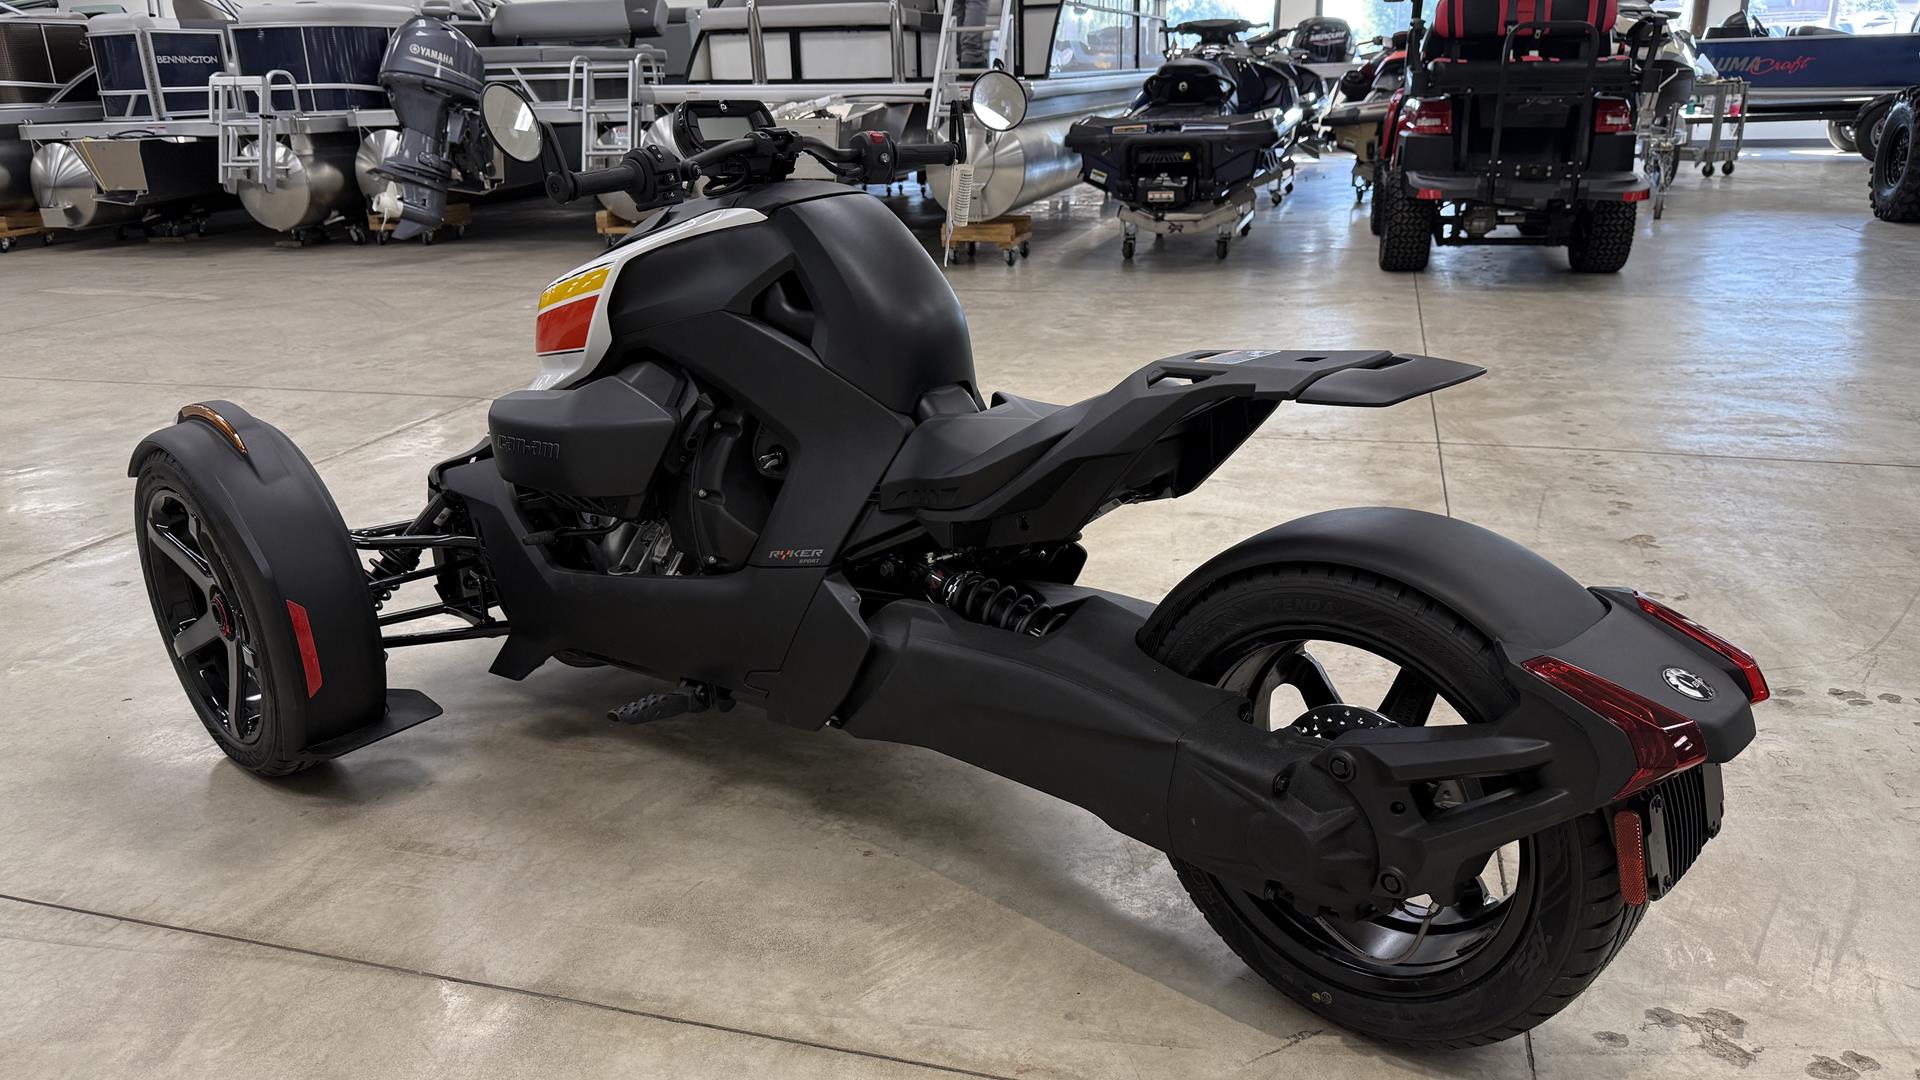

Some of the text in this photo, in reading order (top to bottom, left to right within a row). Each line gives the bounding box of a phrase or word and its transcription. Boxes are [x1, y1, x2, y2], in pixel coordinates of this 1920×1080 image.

[156, 55, 218, 64] BENNINGTON
[420, 46, 454, 66] YAMAHA
[498, 434, 560, 461] can-am
[769, 549, 823, 560] RYKER
